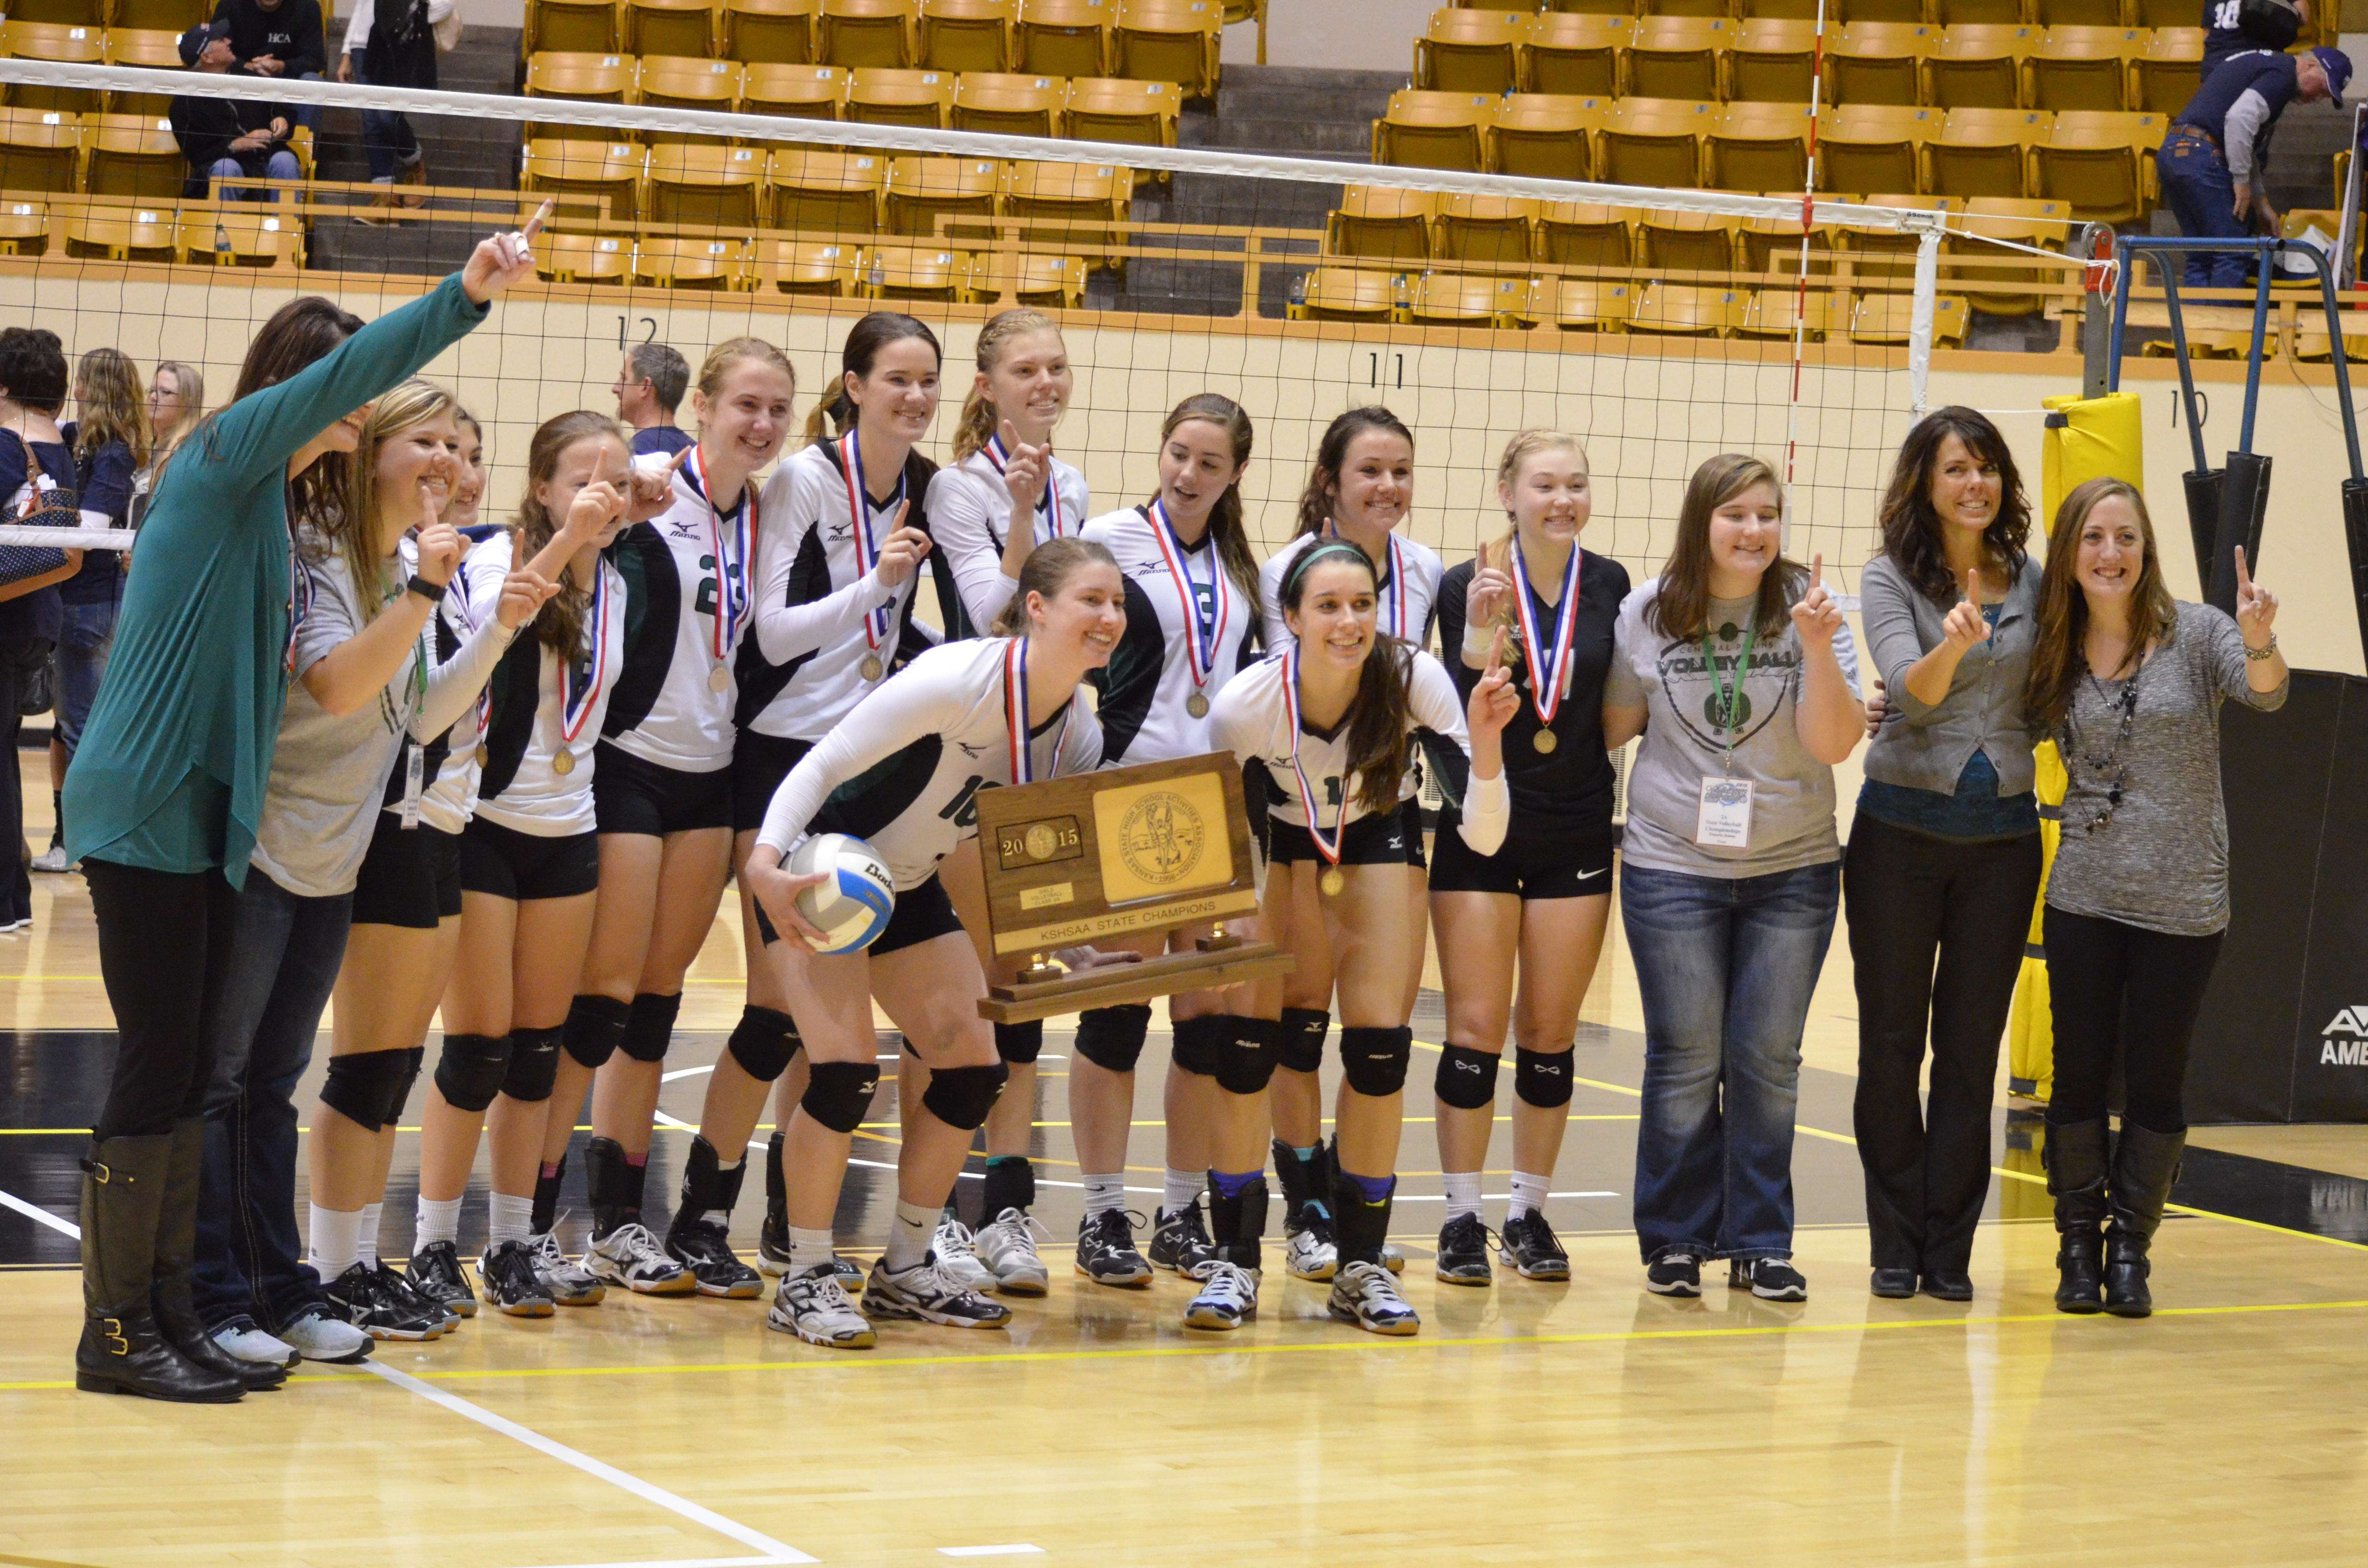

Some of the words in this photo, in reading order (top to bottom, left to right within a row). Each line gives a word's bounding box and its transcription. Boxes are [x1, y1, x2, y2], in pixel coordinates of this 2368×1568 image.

[983, 164, 988, 173] 2
[618, 316, 656, 350] 12
[1370, 353, 1402, 390] 11
[1679, 645, 1731, 653] CENRAL
[1003, 839, 1023, 856] 20
[1059, 829, 1078, 846] 15
[1041, 924, 1090, 941] KSHSAA
[1098, 915, 1136, 930] STATE
[1143, 901, 1216, 922] CHAMPIONS
